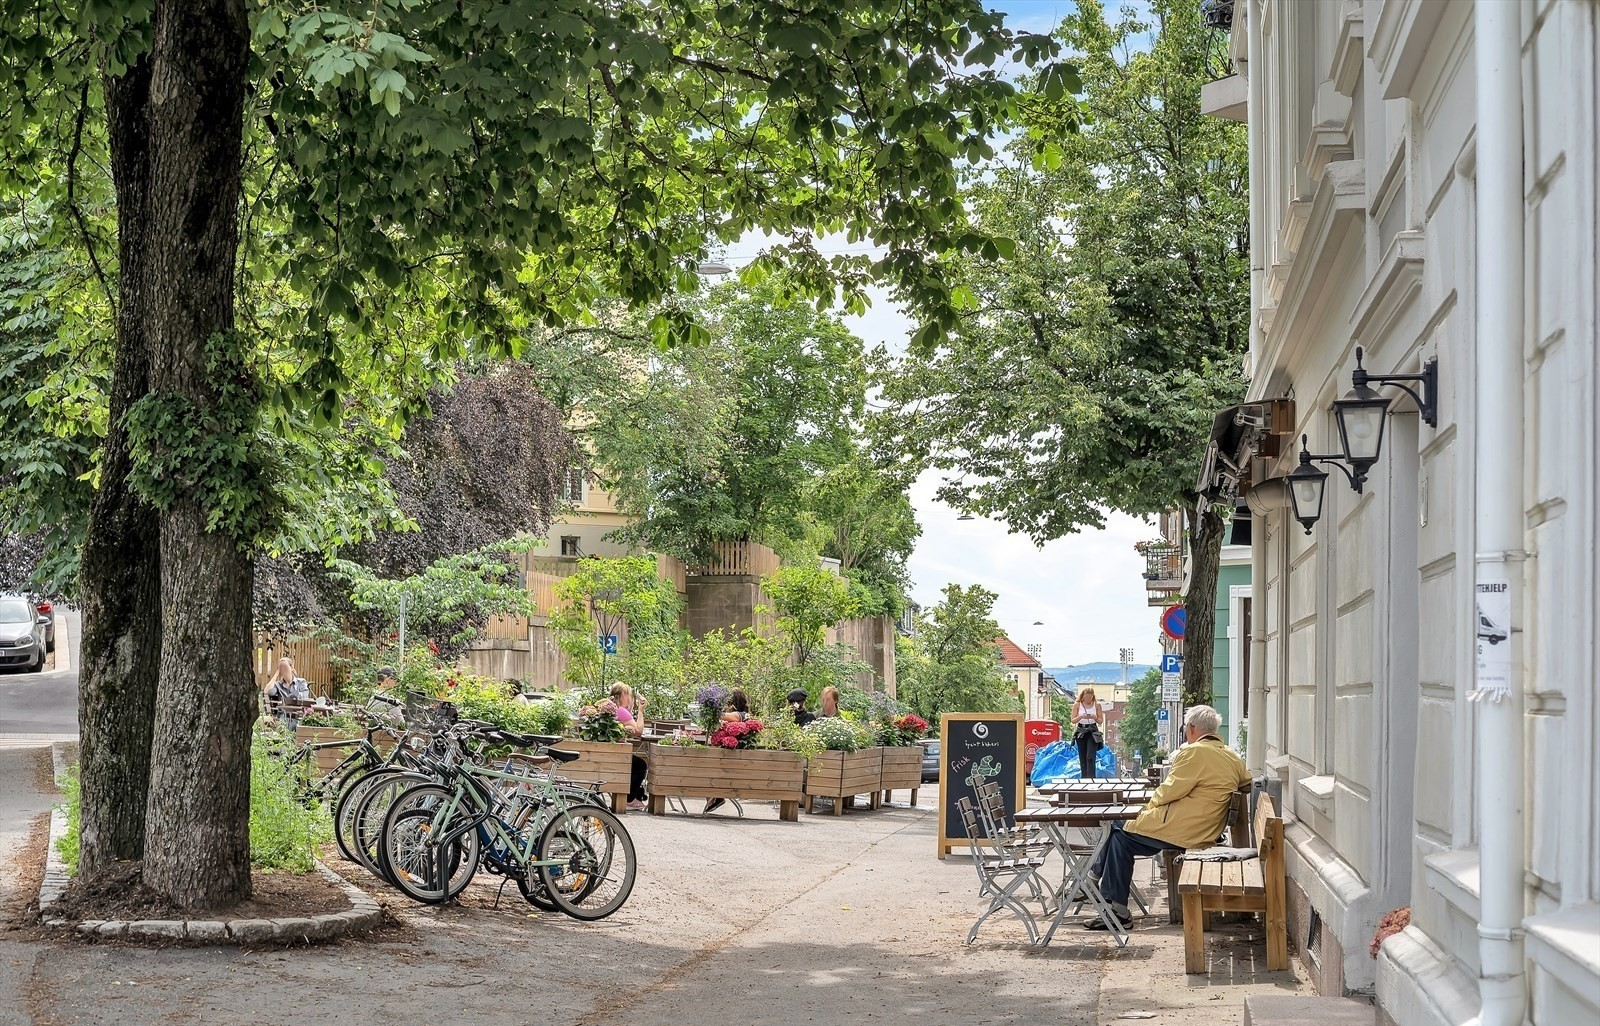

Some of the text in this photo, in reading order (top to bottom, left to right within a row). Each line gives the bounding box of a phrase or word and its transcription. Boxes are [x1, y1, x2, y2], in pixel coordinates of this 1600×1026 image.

[1166, 657, 1176, 670] P
[1160, 711, 1167, 719] P
[951, 756, 970, 773] frisk
